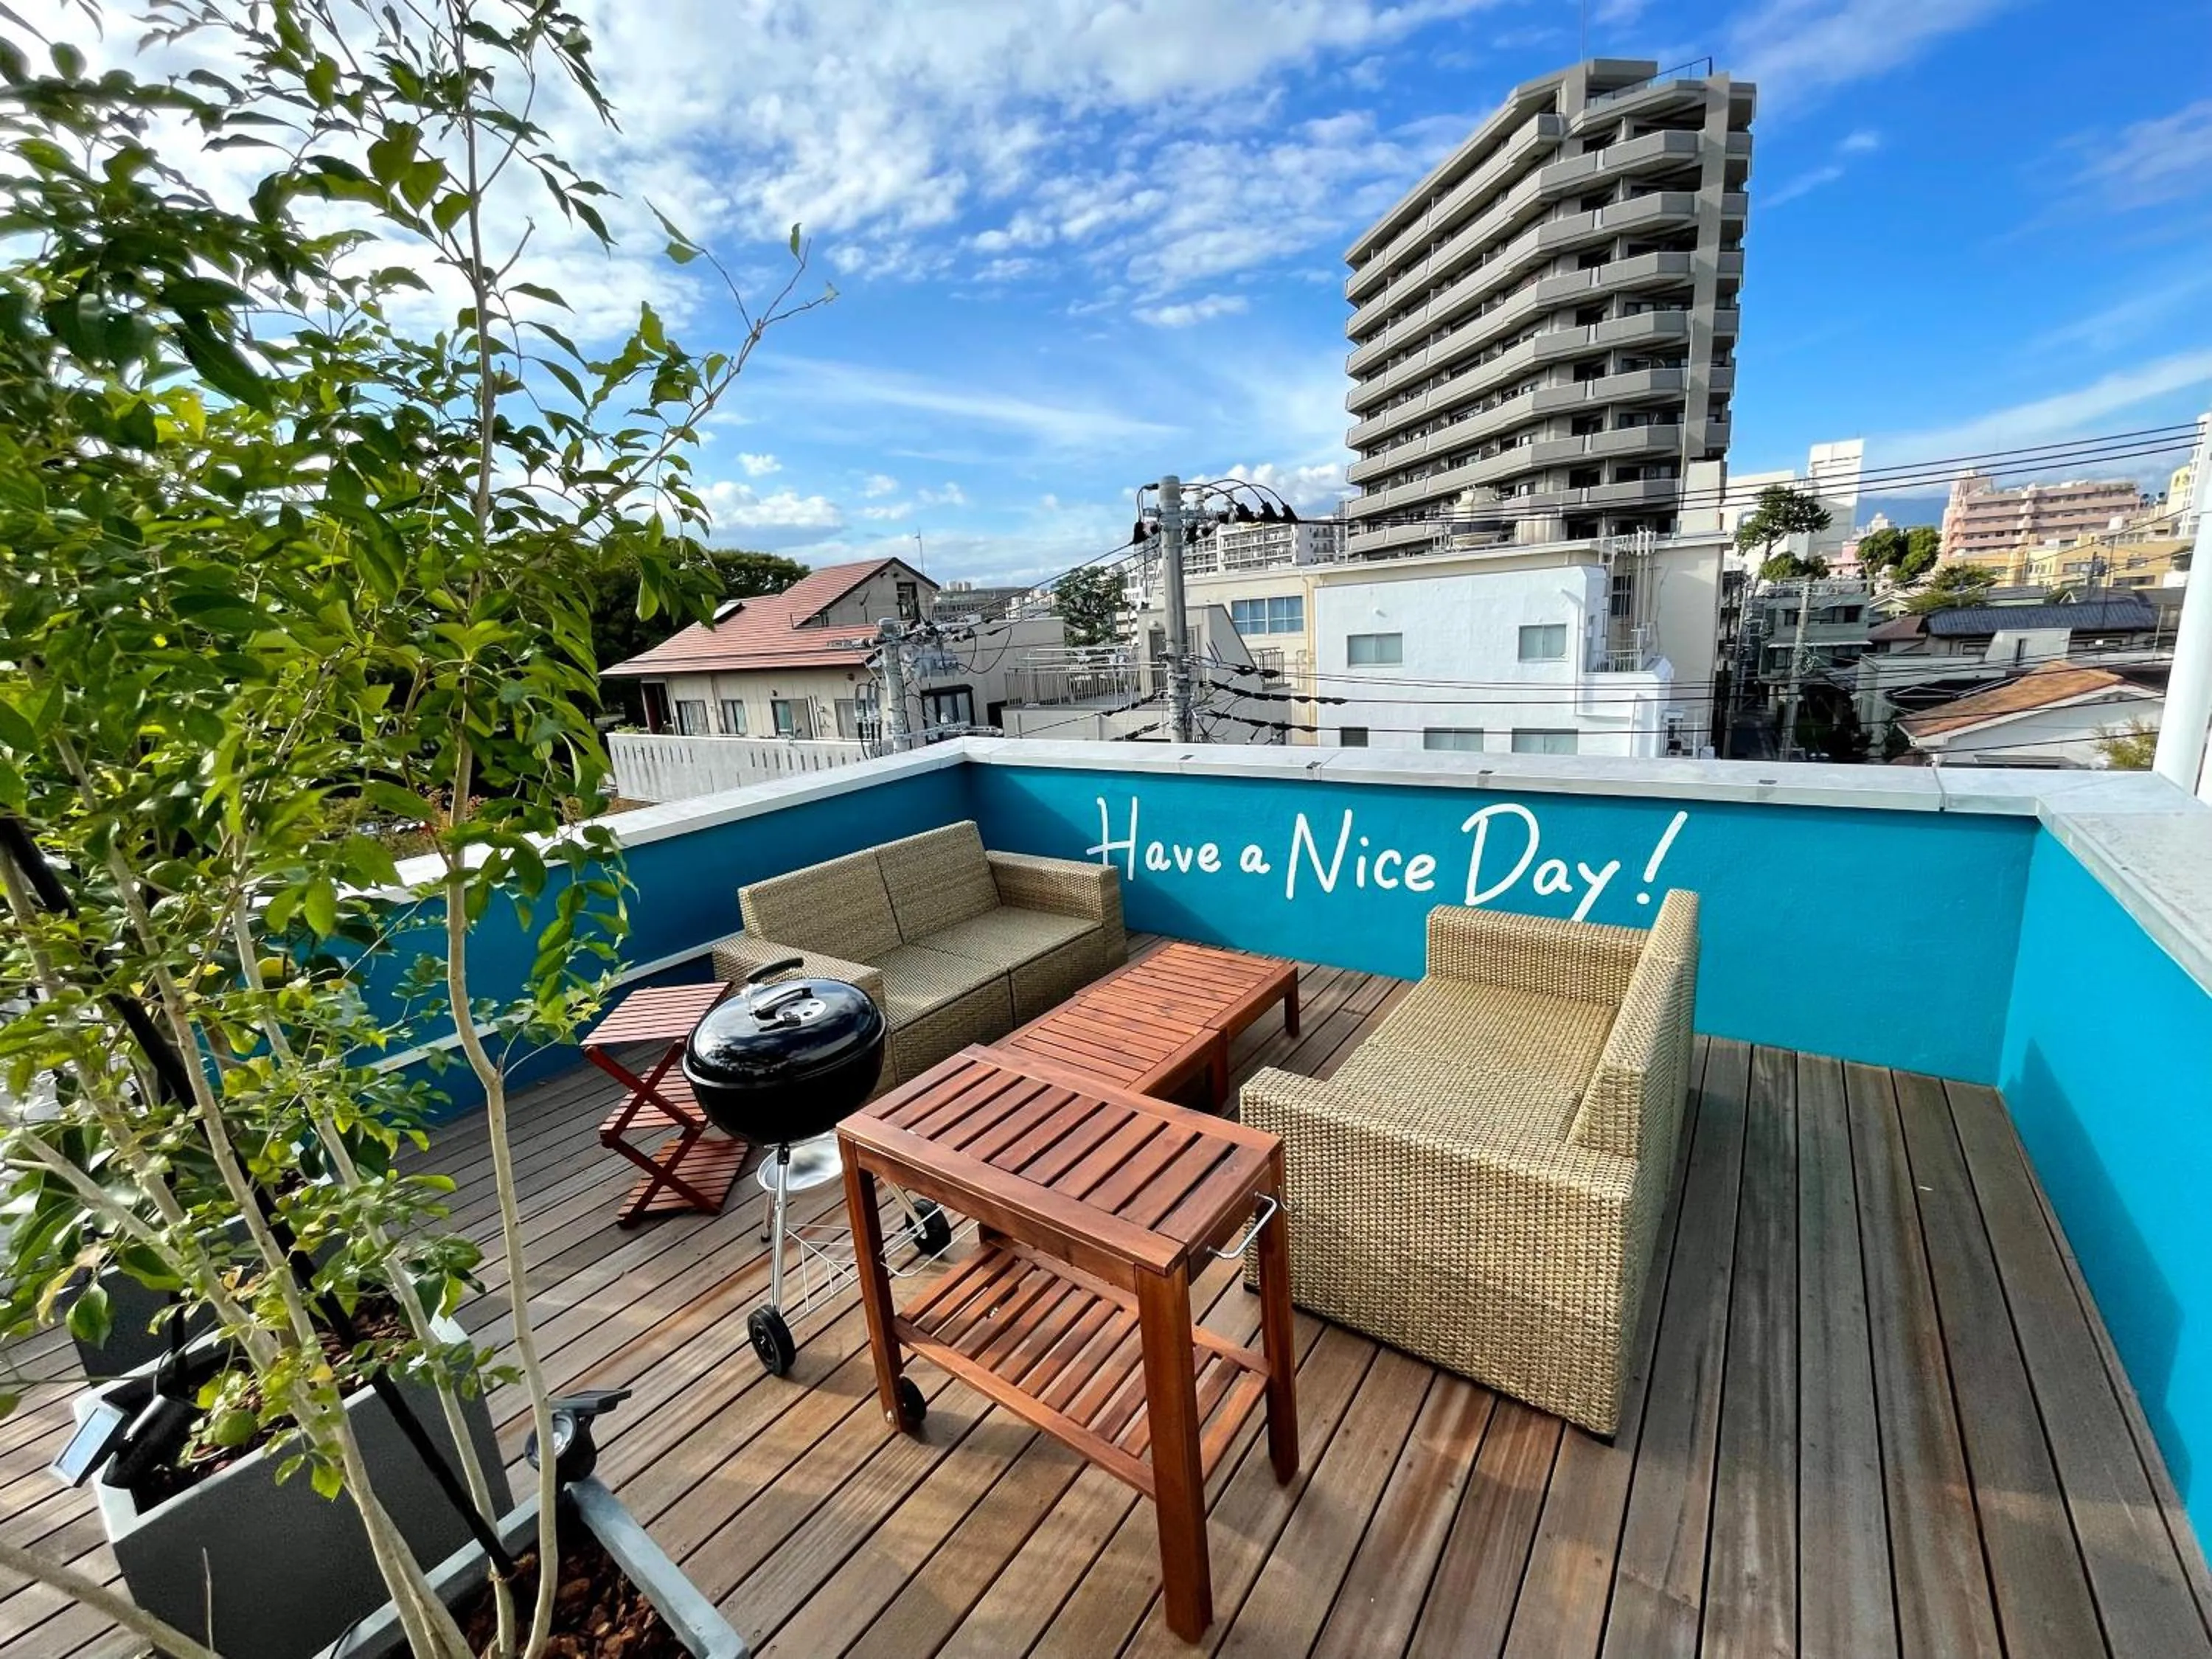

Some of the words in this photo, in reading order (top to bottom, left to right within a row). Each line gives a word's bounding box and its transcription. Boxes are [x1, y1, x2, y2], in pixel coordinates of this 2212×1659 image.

[1086, 796, 1222, 881] Have
[1239, 844, 1270, 874] a
[1286, 809, 1436, 900] Nice
